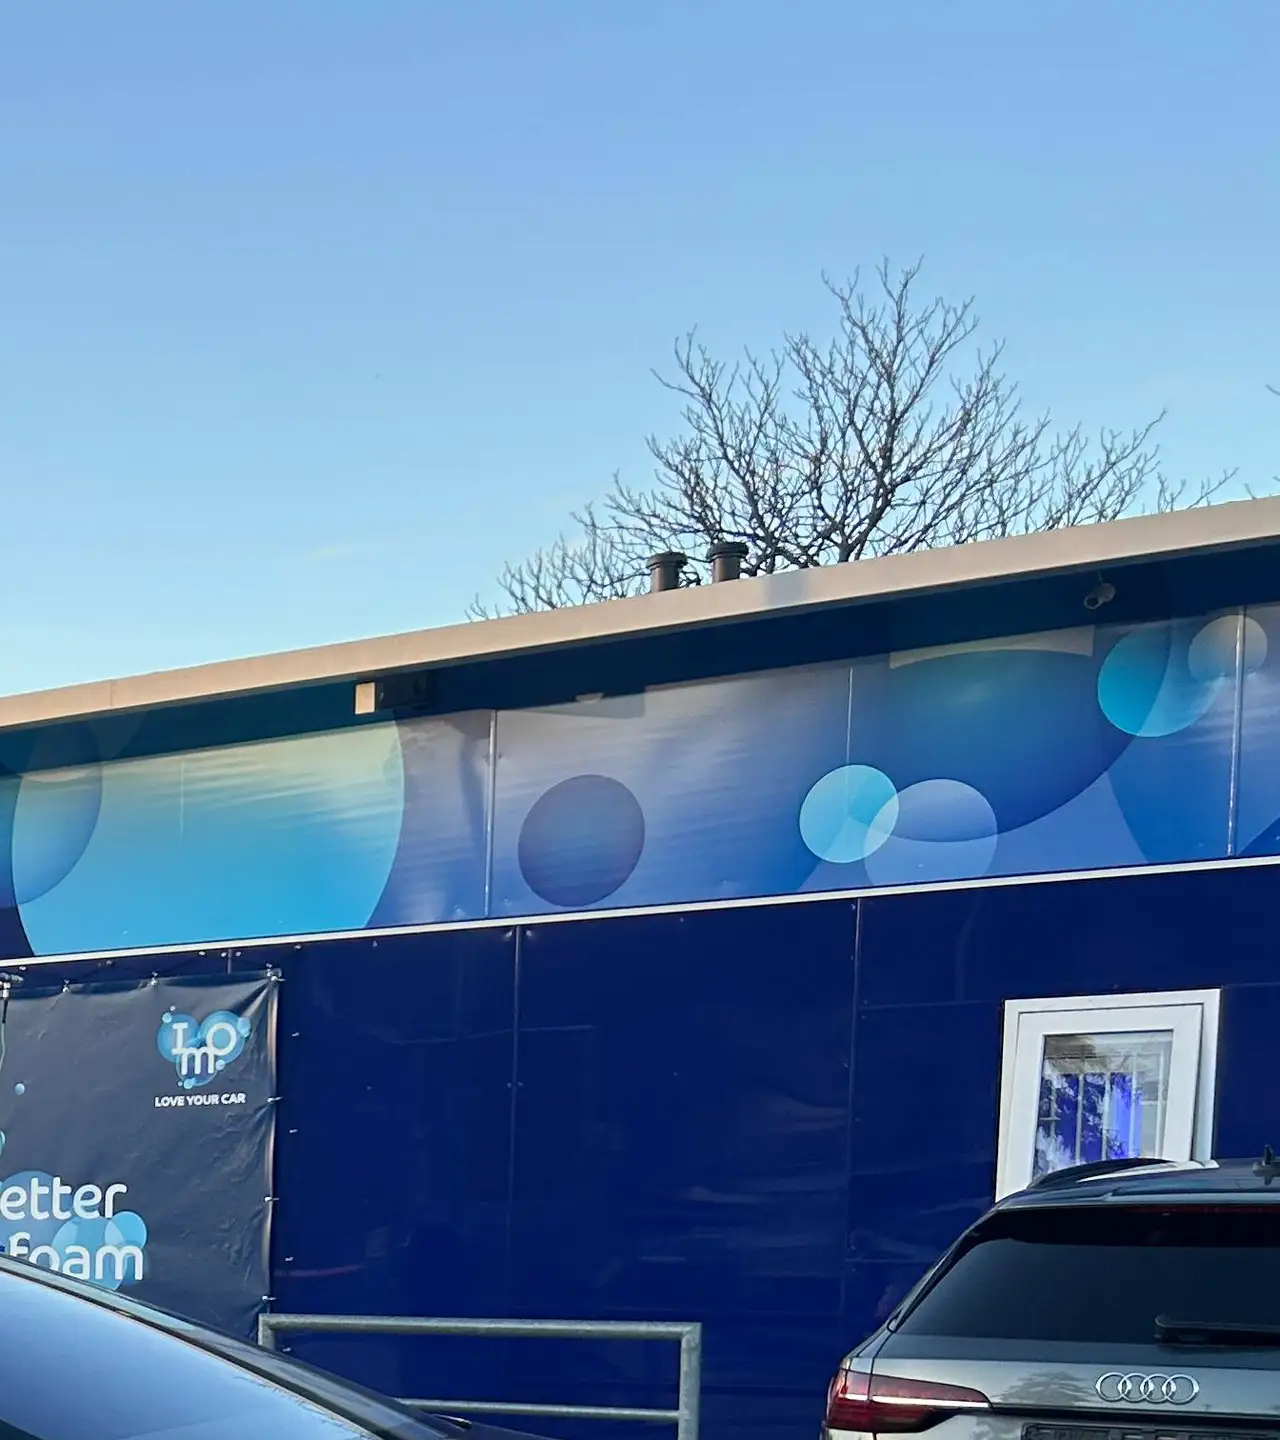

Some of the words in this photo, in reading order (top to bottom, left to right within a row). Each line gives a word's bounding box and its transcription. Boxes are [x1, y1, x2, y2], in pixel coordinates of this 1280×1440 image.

[154, 1095, 185, 1107] LOVE
[186, 1094, 220, 1106] YOUR
[220, 1092, 246, 1105] CAR
[8, 1231, 144, 1280] foam
